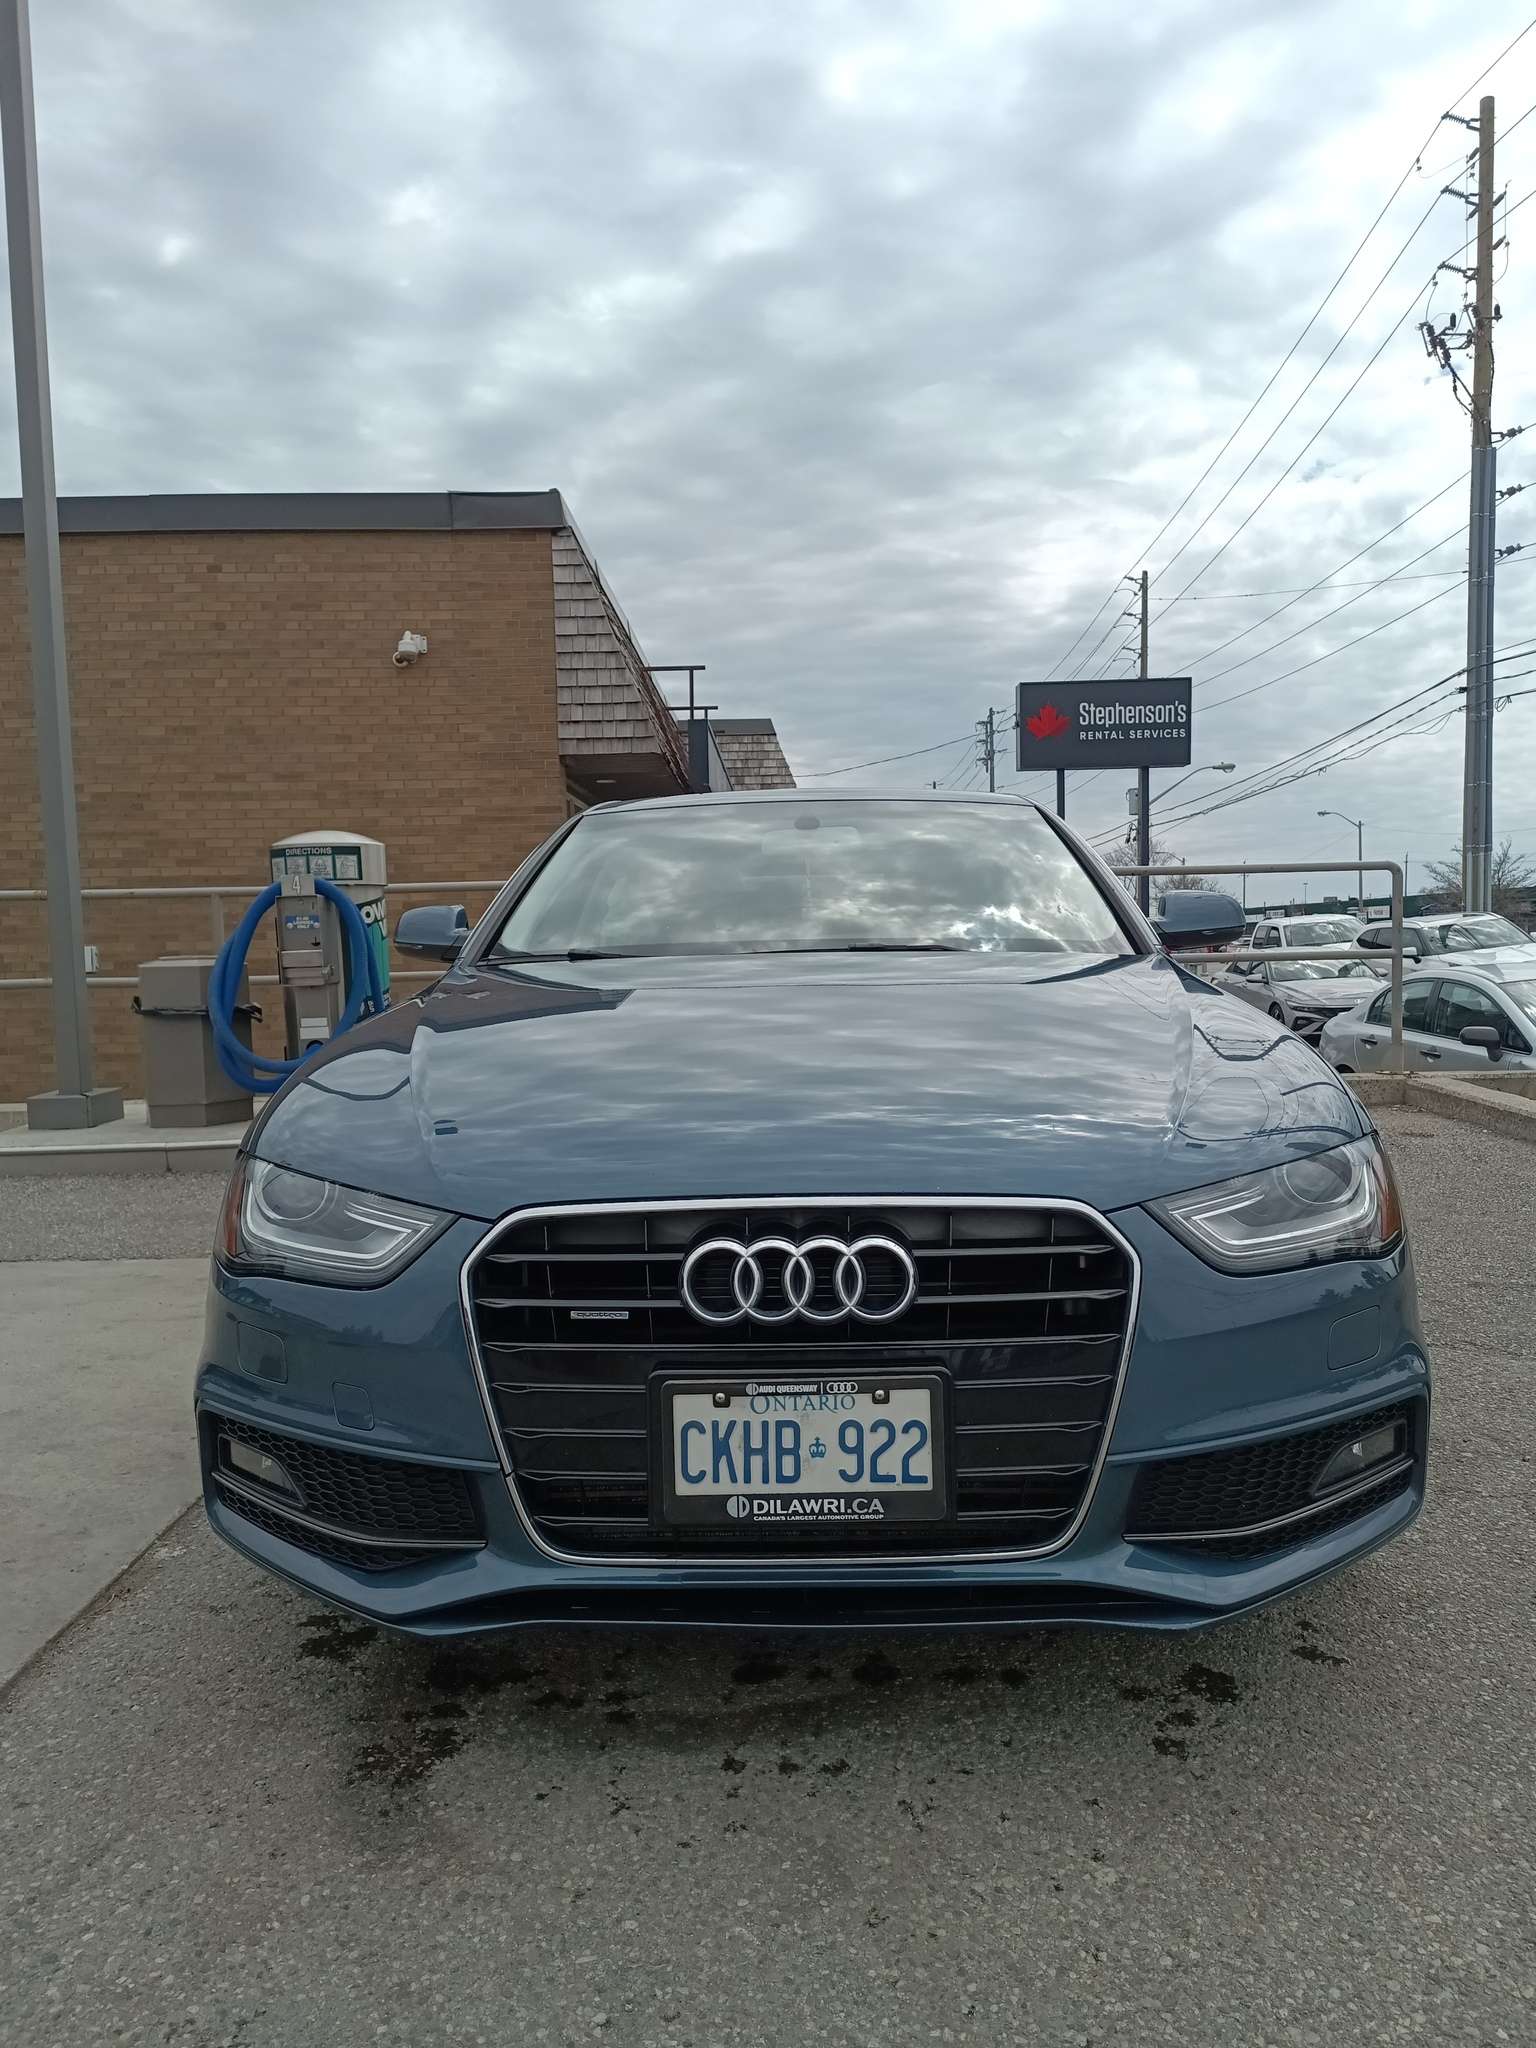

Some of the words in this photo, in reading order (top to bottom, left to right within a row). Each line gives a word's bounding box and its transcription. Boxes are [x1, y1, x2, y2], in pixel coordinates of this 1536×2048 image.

[1079, 701, 1187, 728] Stephenson's
[1079, 730, 1125, 741] RENTAL
[1129, 728, 1186, 739] SERVICES
[285, 847, 332, 856] DIRECTIONS
[292, 875, 301, 896] 4
[759, 1385, 776, 1393] AUDI
[776, 1384, 818, 1393] QUEENSWAY
[750, 1394, 856, 1415] ONTARIO
[680, 1419, 801, 1485] CKHB
[837, 1418, 929, 1484] 922
[753, 1498, 884, 1514] DILAWRI.CA
